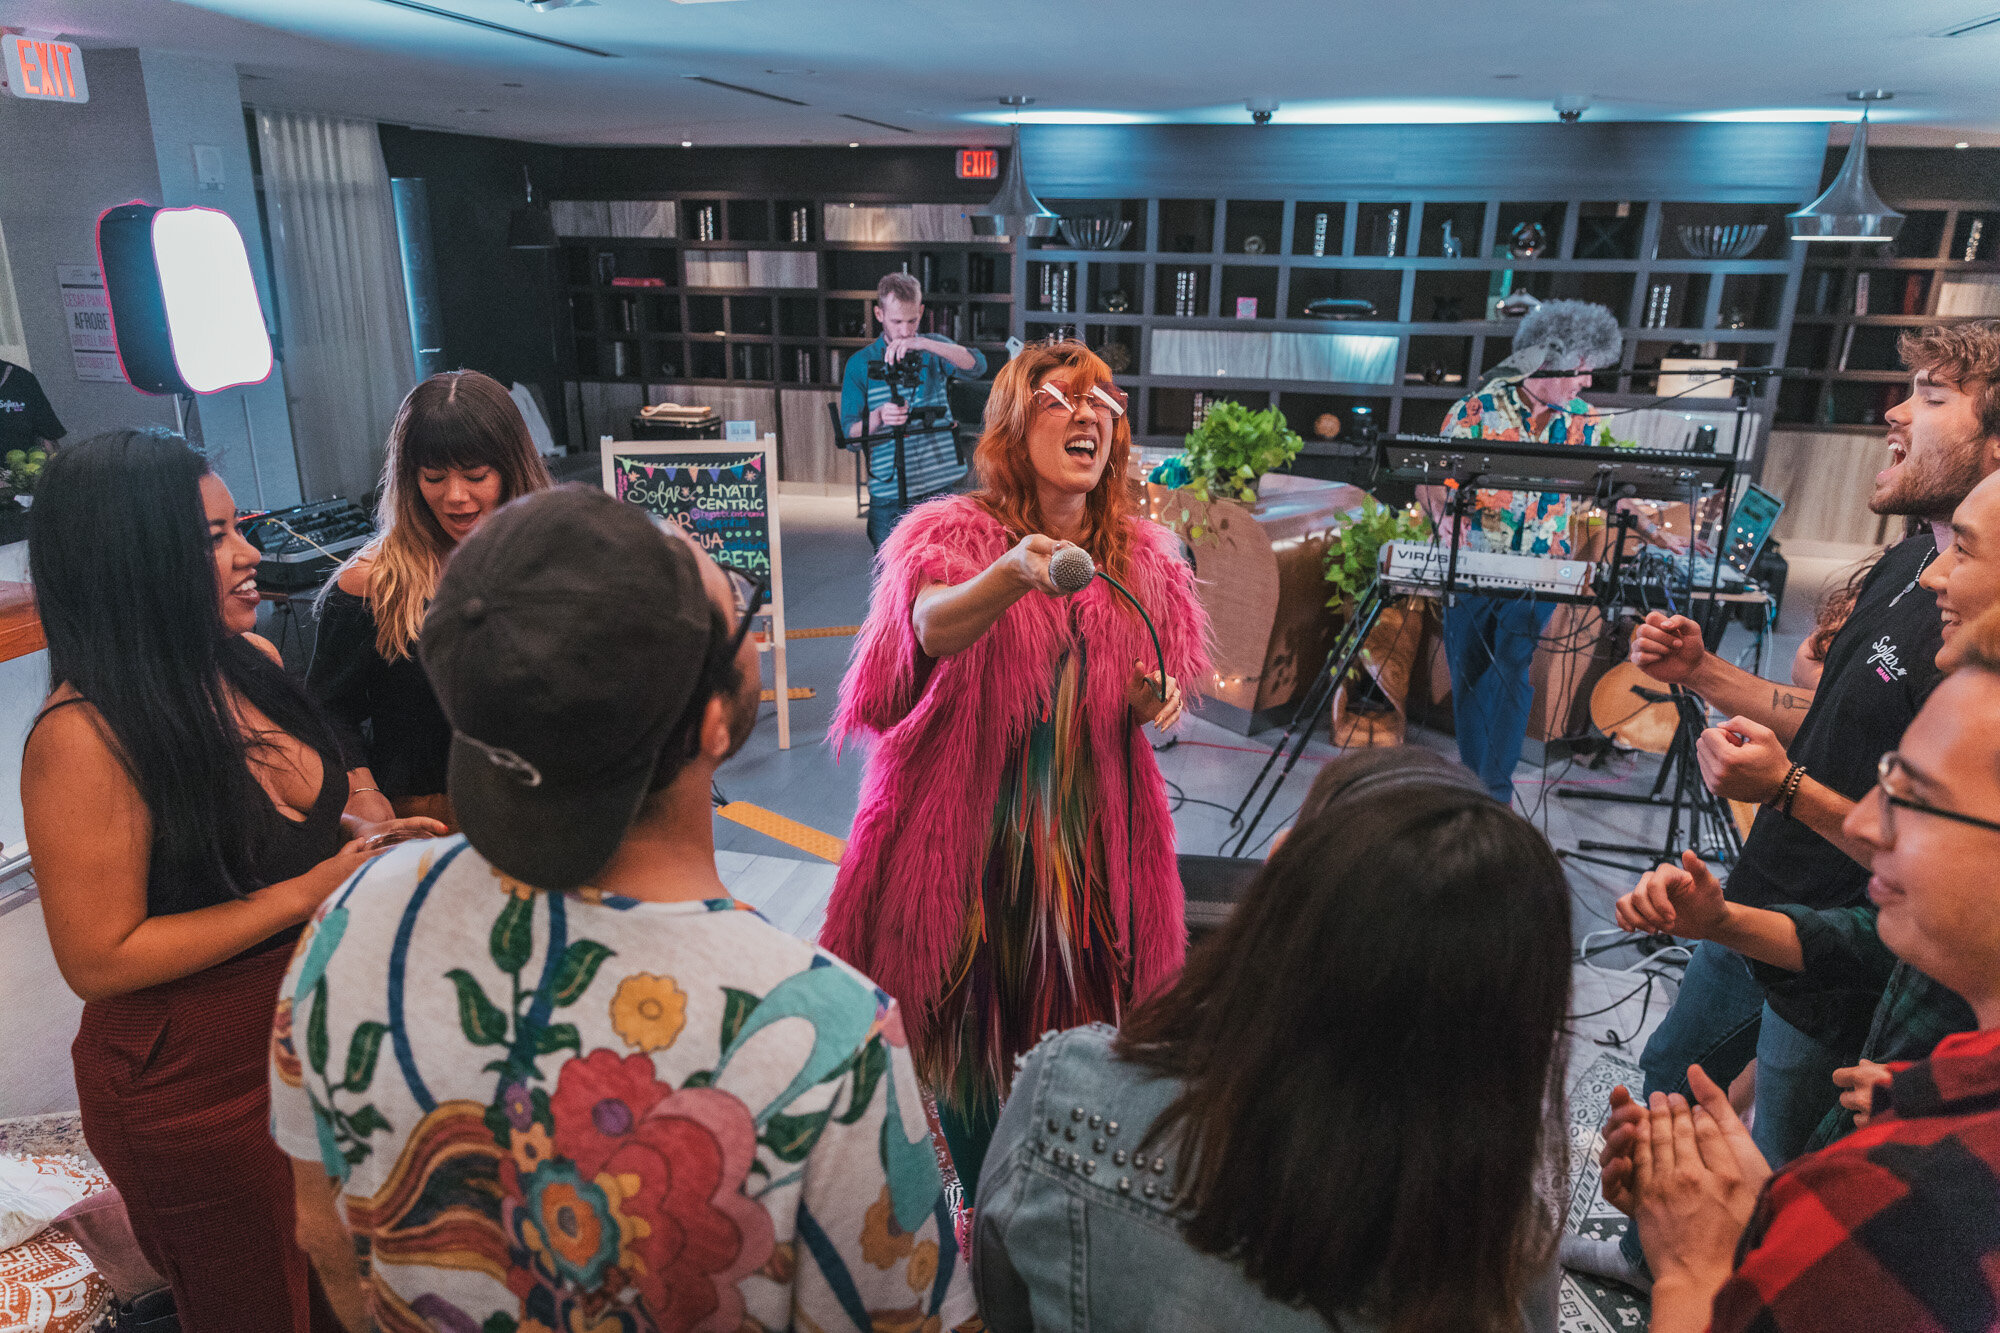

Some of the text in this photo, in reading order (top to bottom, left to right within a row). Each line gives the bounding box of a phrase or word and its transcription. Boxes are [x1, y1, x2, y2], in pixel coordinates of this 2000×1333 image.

[16, 39, 76, 98] EXIT
[962, 150, 993, 178] EXIT
[74, 312, 110, 330] AFROBE
[627, 479, 687, 508] Sofar
[709, 483, 758, 498] HYATT
[697, 497, 764, 510] CENTRIC
[1397, 549, 1448, 563] VIRUS
[1867, 635, 1902, 671] Sofar
